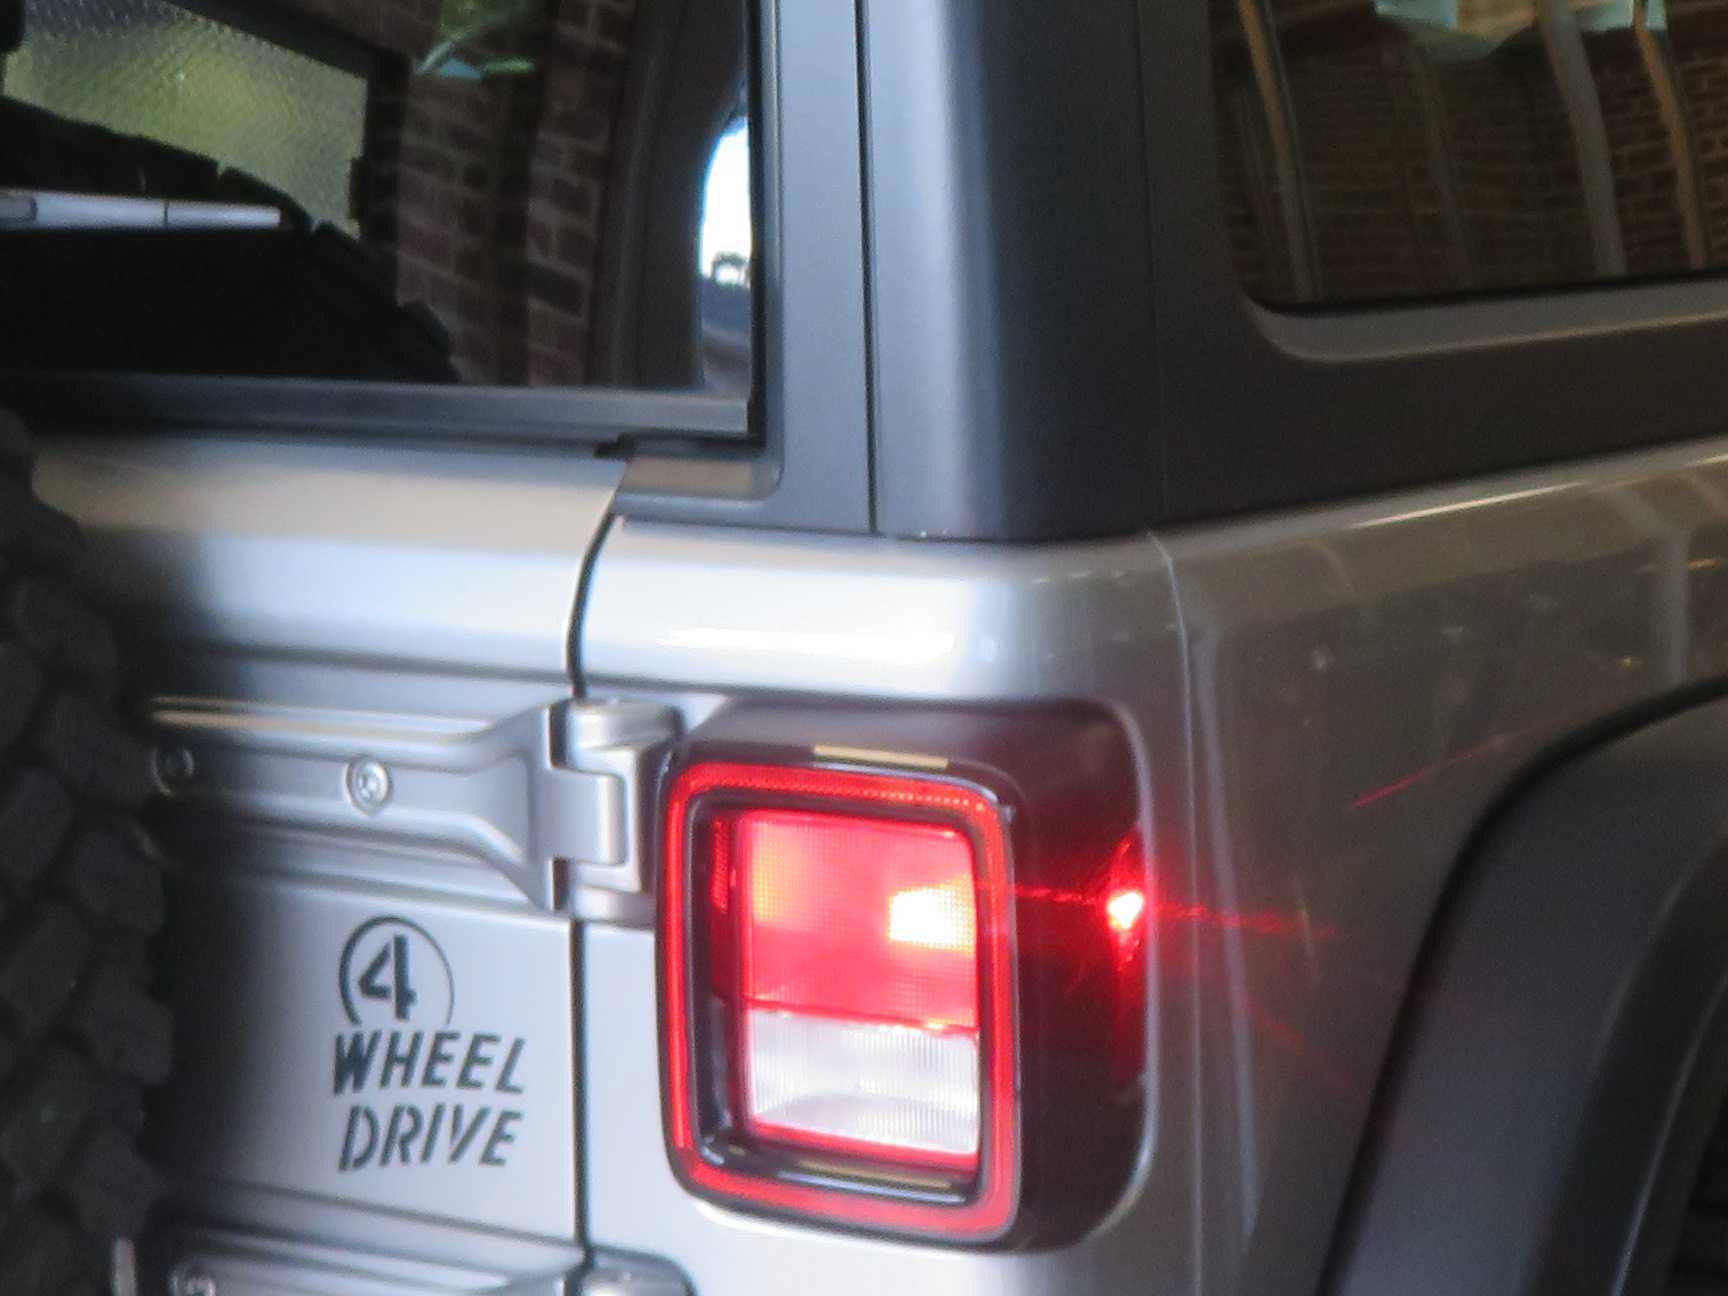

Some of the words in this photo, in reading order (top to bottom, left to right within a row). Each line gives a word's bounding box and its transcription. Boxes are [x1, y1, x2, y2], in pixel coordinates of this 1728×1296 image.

[357, 933, 417, 1022] 4
[331, 1029, 526, 1096] WHEEL
[336, 1102, 524, 1174] DRIVE
